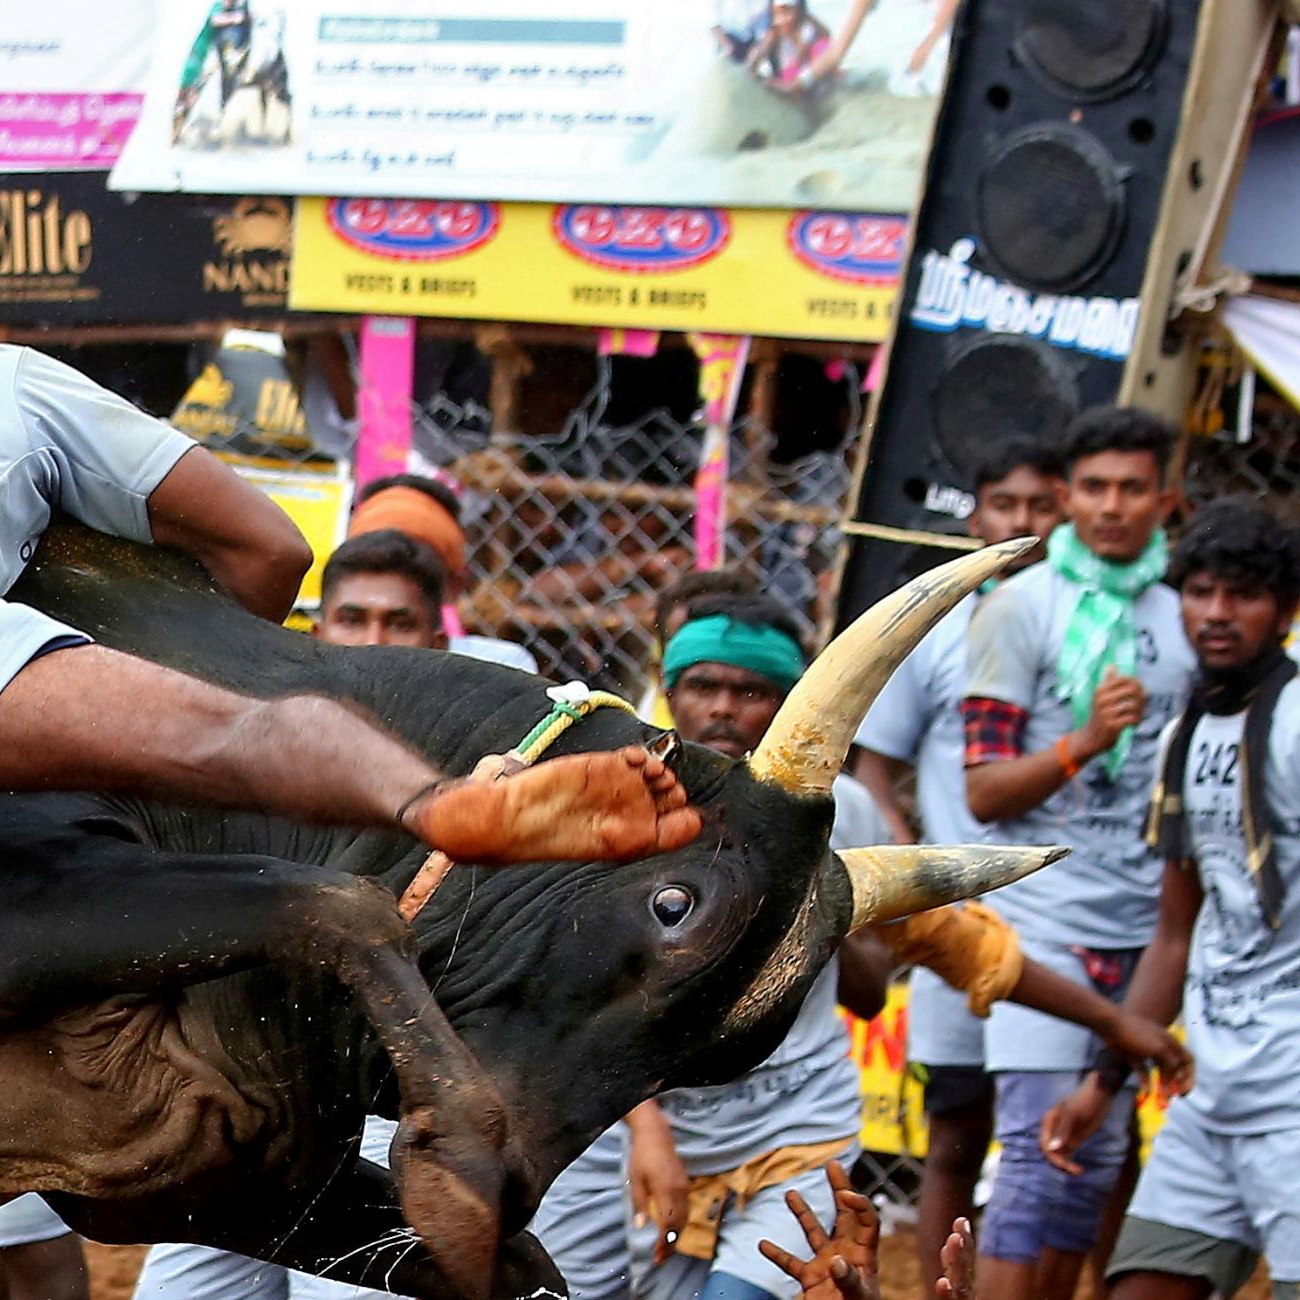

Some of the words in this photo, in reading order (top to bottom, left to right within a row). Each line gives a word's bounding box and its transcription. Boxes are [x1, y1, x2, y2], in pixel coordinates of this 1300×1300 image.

[806, 213, 904, 260] OZ
[203, 261, 288, 293] NAND
[346, 274, 393, 292] VESTS
[401, 277, 412, 293] &
[420, 279, 476, 297] BRIEFS
